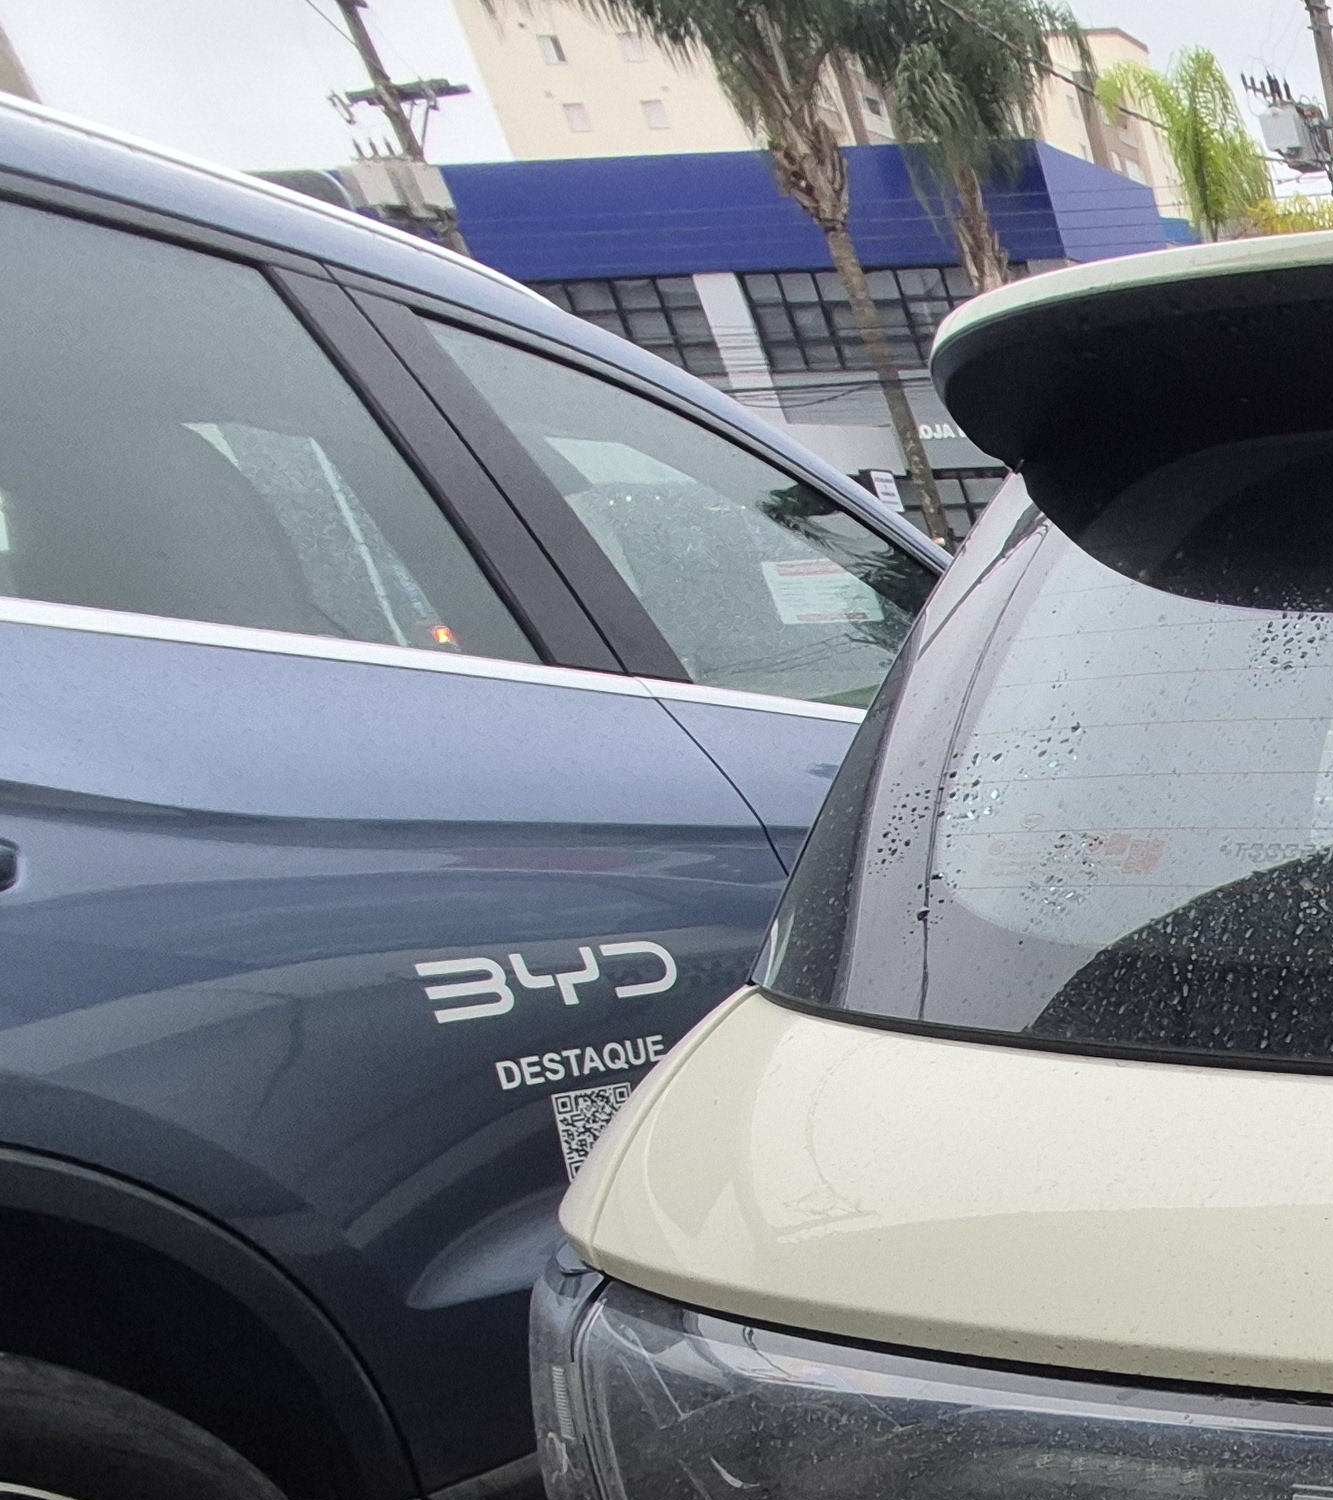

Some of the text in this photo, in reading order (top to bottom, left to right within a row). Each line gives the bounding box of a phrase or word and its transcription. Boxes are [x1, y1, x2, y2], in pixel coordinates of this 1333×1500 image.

[919, 423, 955, 439] OJA
[414, 940, 678, 1024] BYD
[495, 1035, 666, 1090] DESTAQUE
